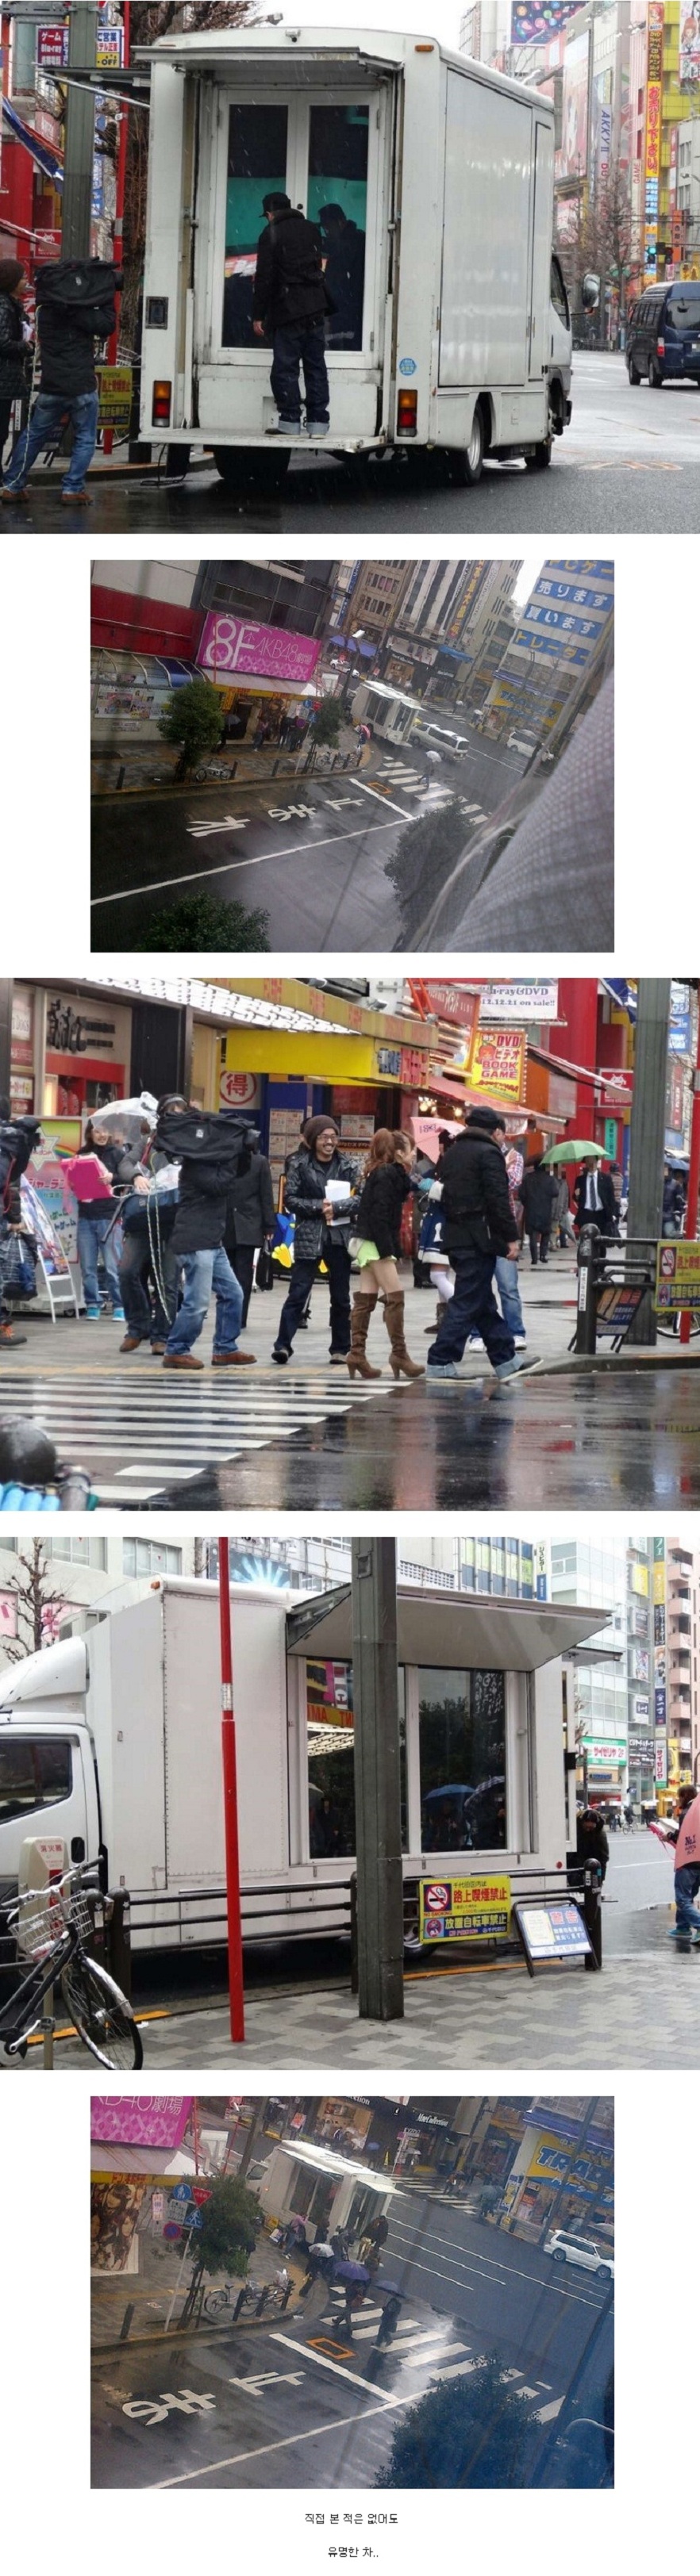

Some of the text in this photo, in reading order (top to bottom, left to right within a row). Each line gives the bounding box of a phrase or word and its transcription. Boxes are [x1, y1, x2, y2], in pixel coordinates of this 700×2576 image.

[41, 32, 61, 42] ゲーム
[601, 110, 610, 143] AKKY
[537, 581, 608, 607] 売ります
[526, 605, 595, 634] 買います
[206, 618, 260, 669] 8F
[496, 1035, 521, 1047] DVD
[482, 1060, 517, 1069] BOOK
[226, 1074, 249, 1096] 得
[453, 1888, 508, 1903] 路上喫煙禁止
[445, 1914, 507, 1930] 放置自転車禁止
